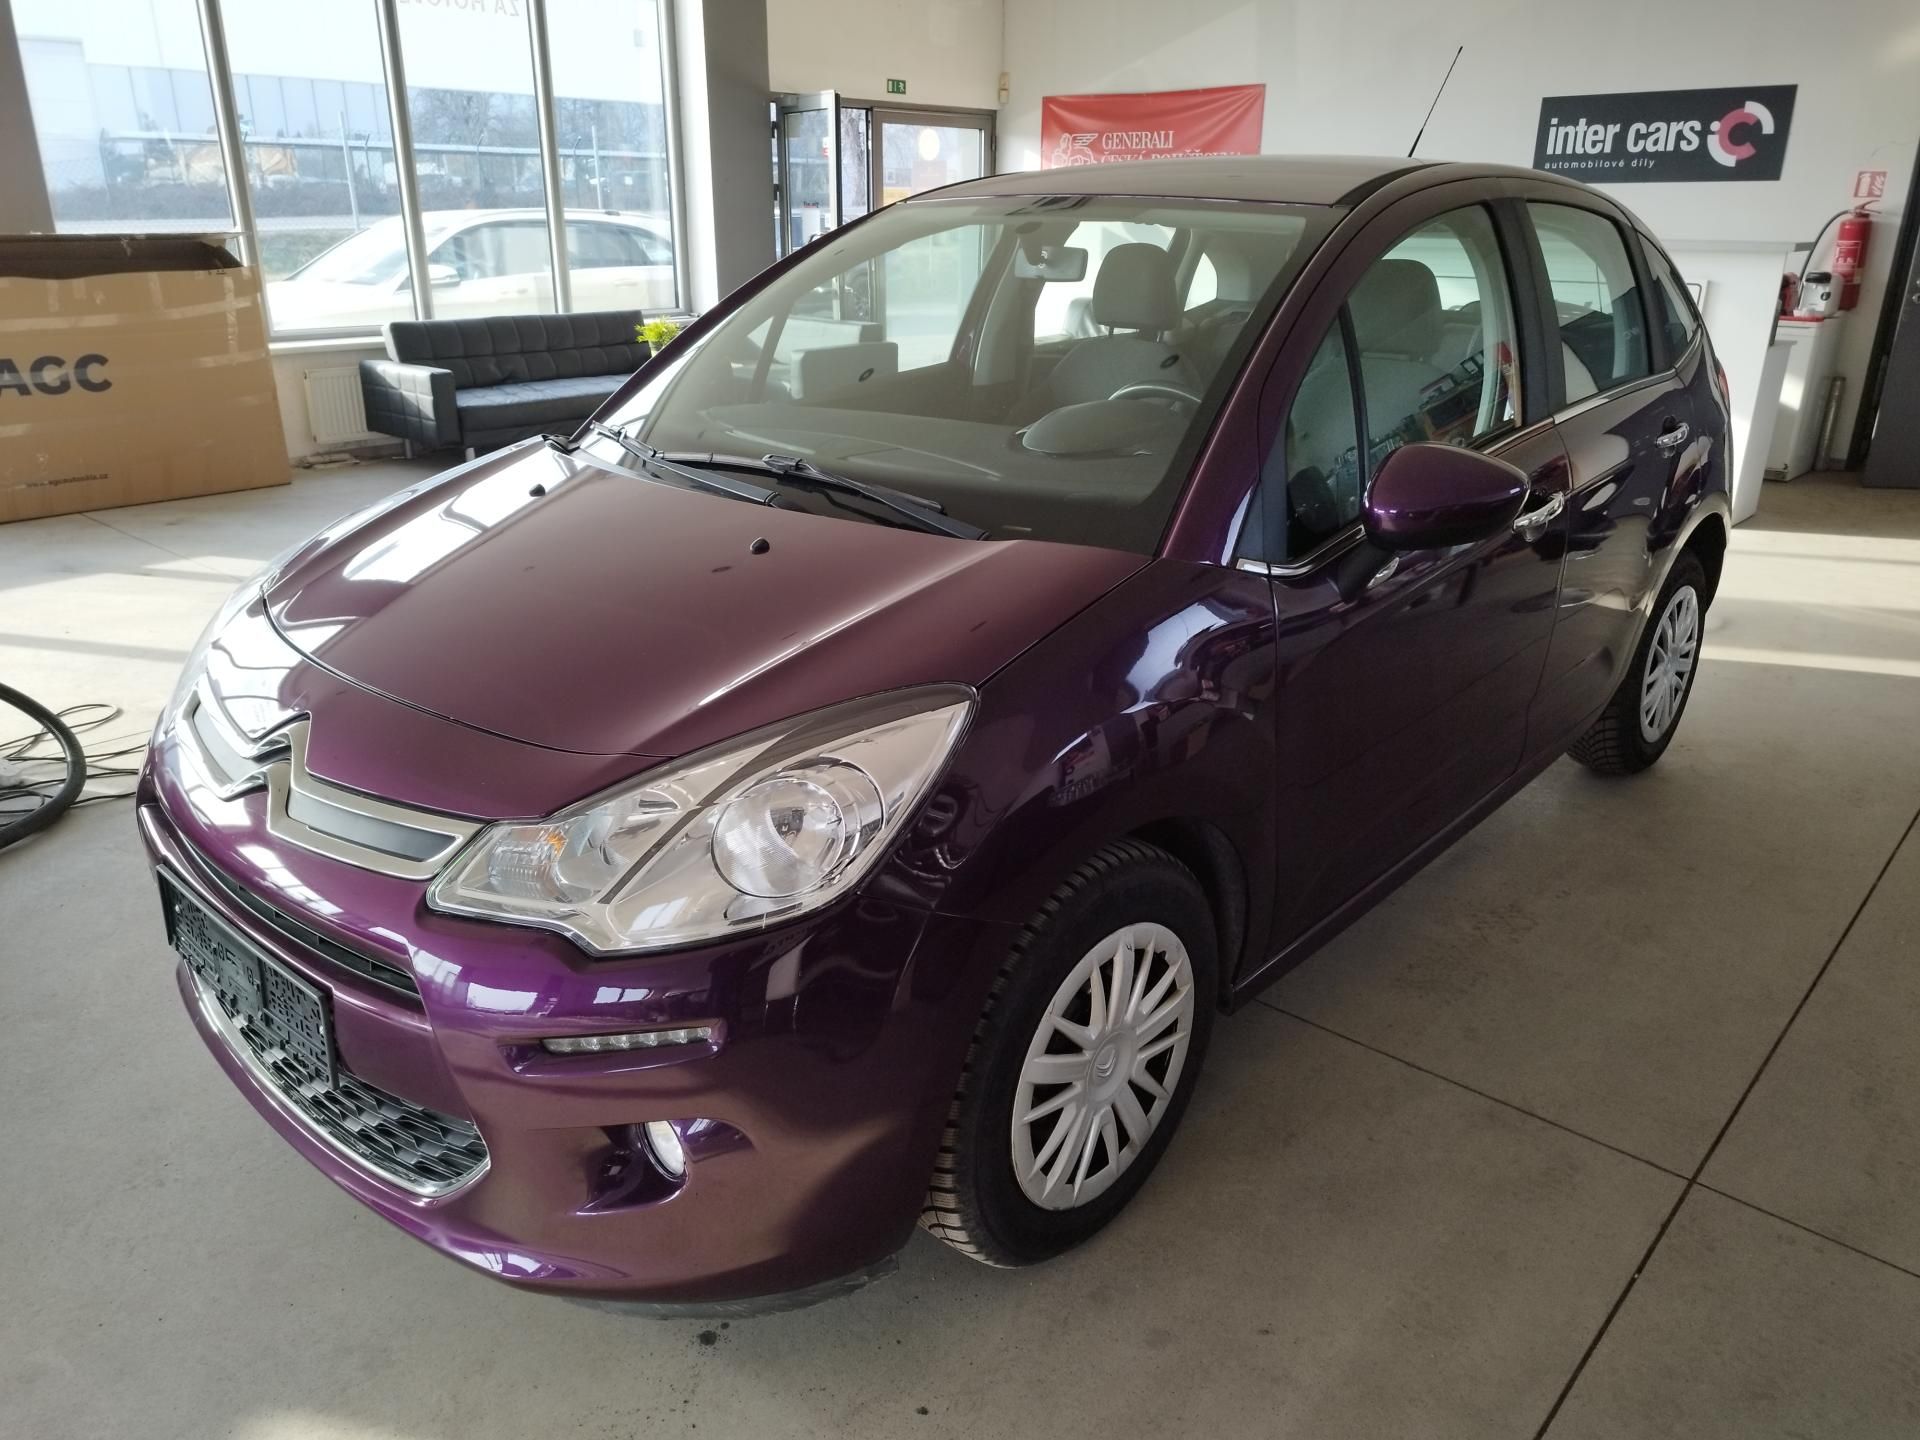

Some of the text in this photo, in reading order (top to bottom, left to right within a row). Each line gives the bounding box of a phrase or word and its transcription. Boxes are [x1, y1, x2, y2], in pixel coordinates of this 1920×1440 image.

[1102, 130, 1176, 150] GENERALI
[1546, 117, 1702, 155] inter cars
[1544, 158, 1656, 169] automobilové díly
[0, 353, 113, 397] AGC
